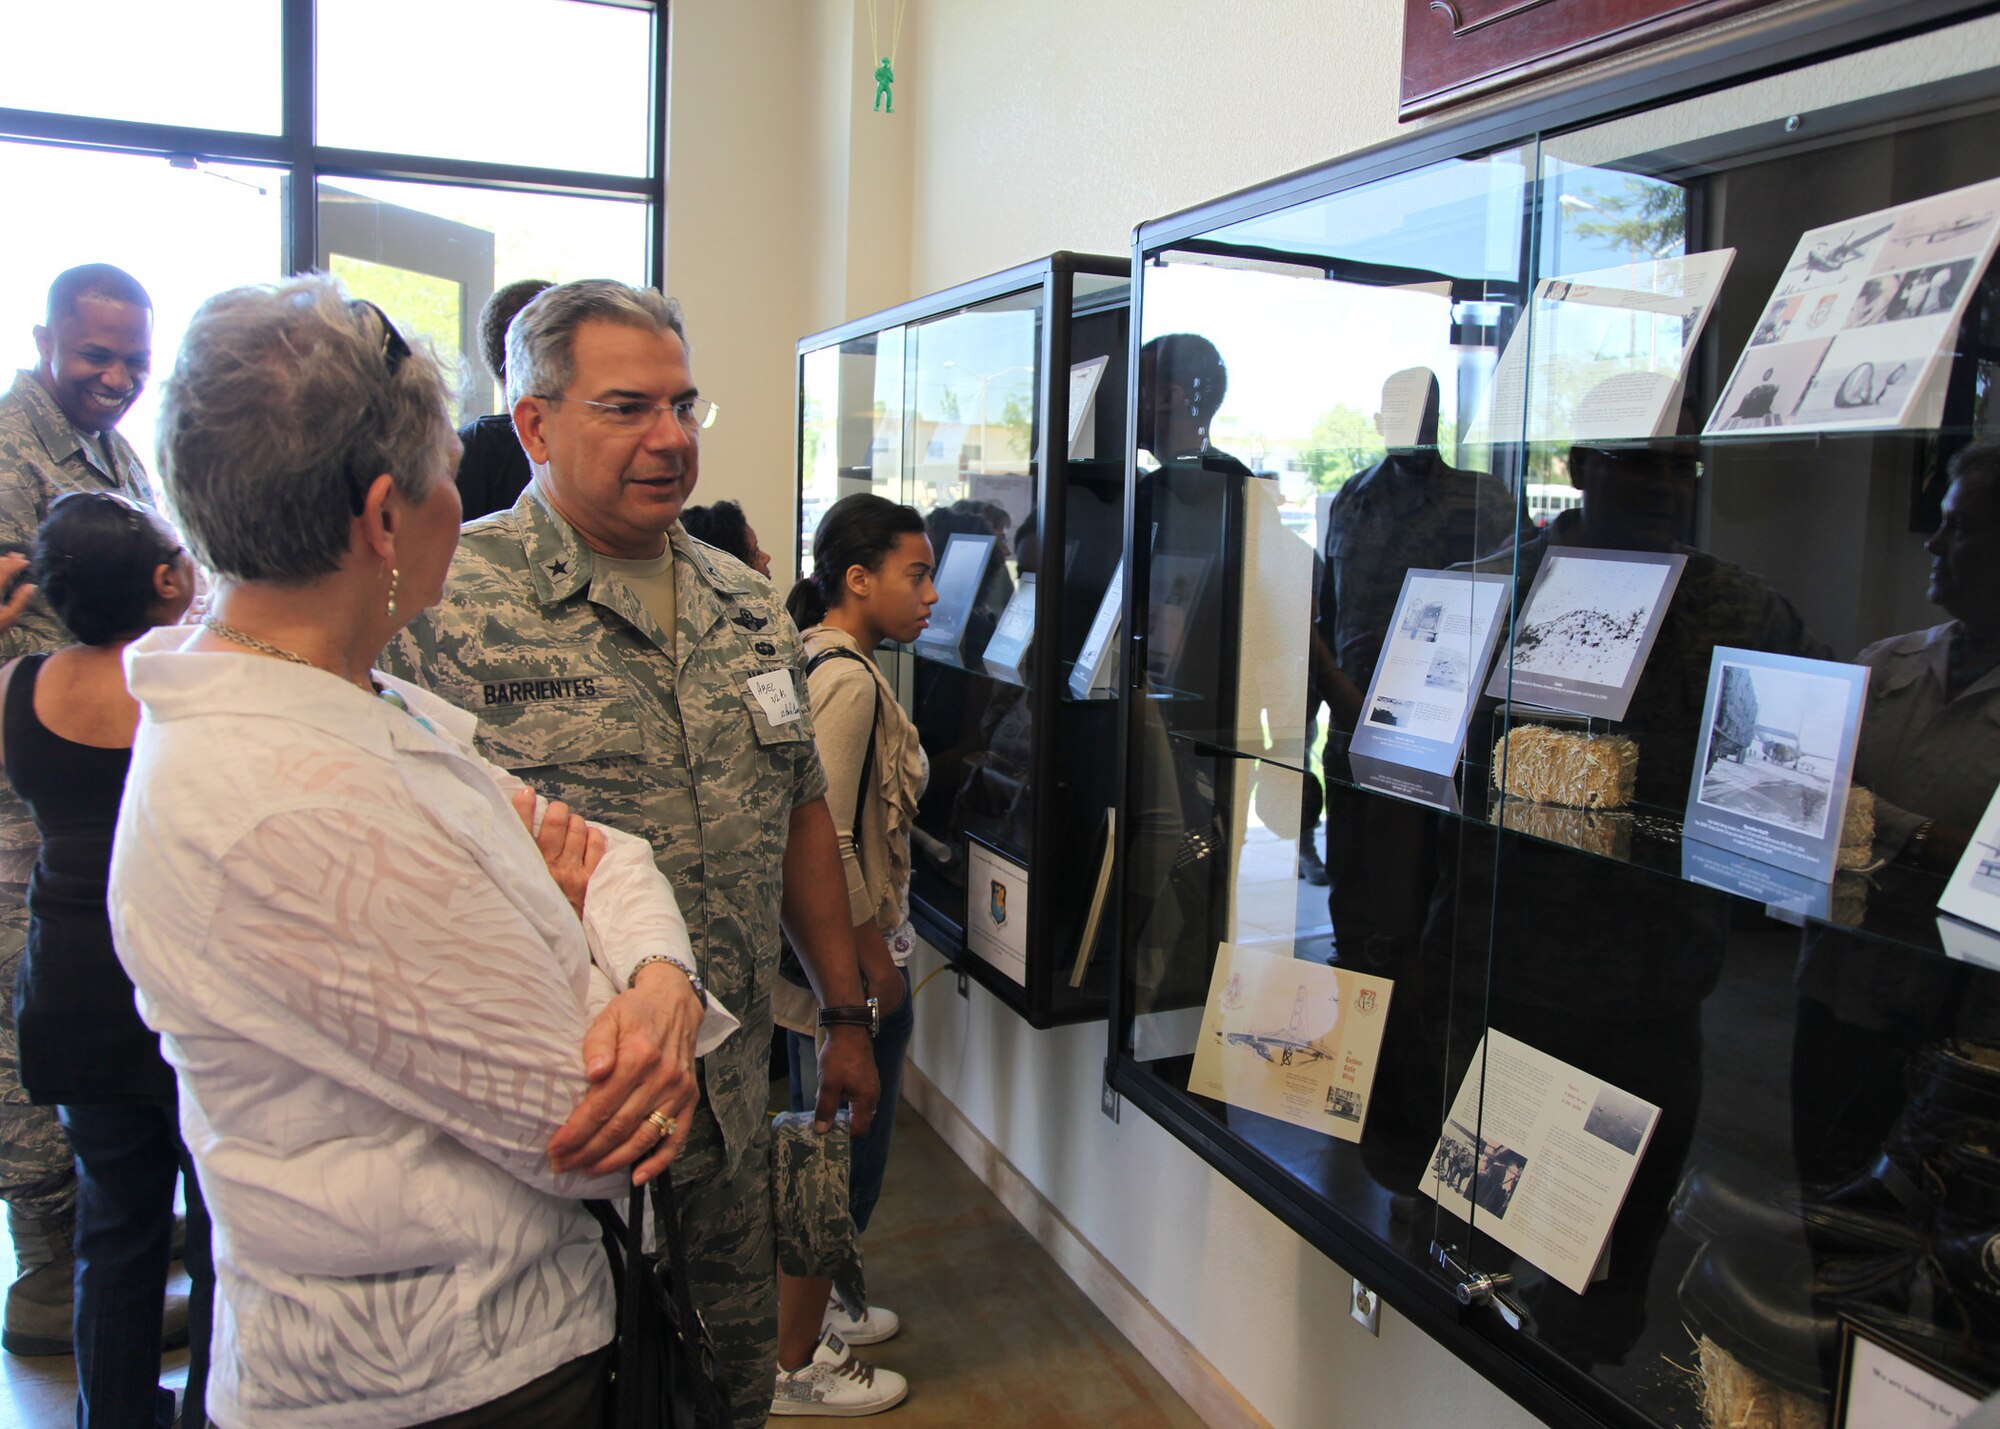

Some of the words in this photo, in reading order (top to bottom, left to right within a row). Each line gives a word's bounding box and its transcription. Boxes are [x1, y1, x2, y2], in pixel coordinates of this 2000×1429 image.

[483, 677, 596, 705] BARRIENTES
[1345, 1056, 1364, 1066] Golden
[1344, 1064, 1356, 1074] Gate
[1342, 1073, 1355, 1083] Wing
[1904, 1385, 1937, 1410] looking
[1938, 1404, 1953, 1417] for
